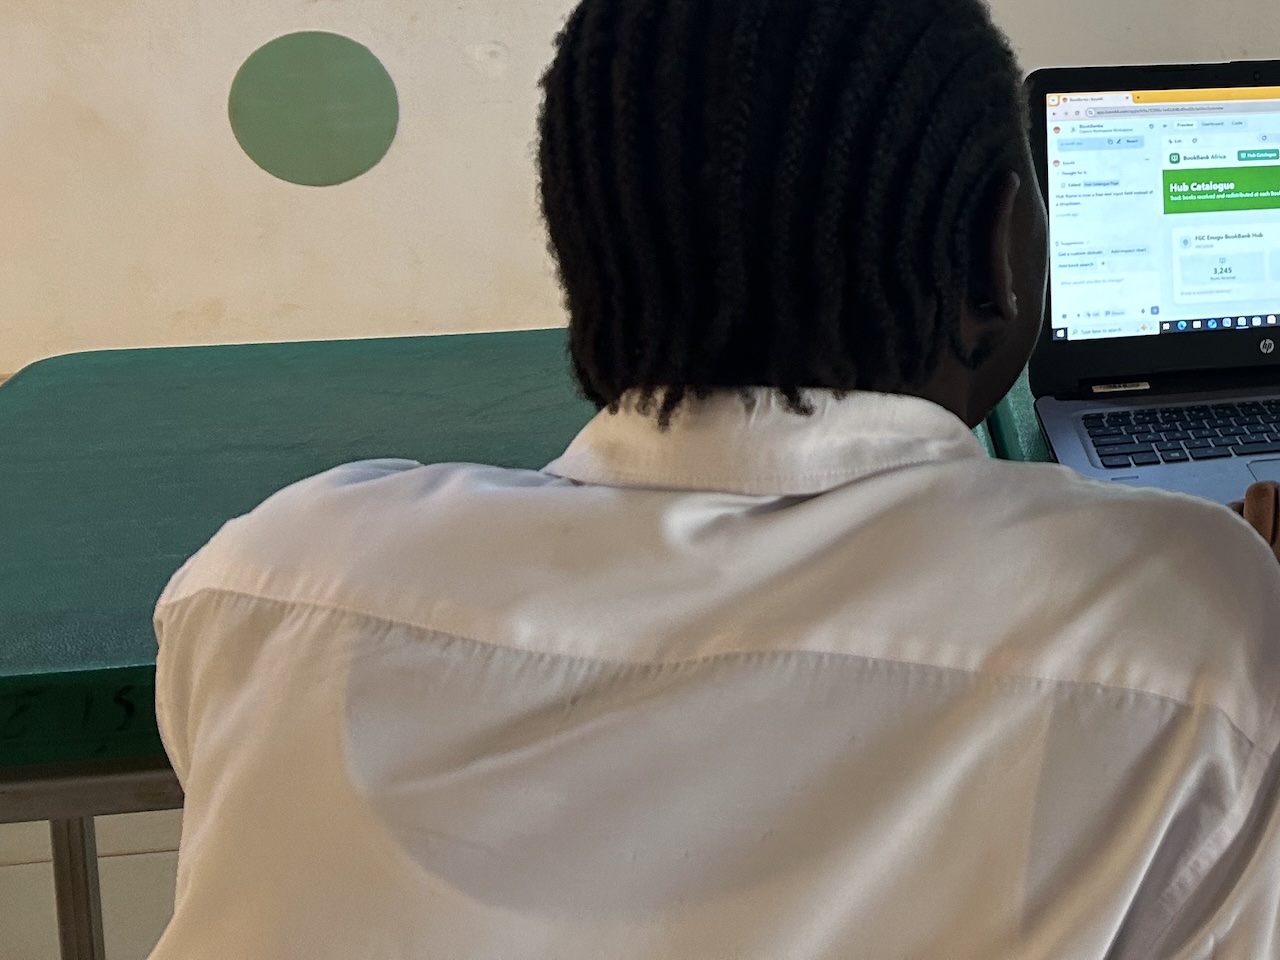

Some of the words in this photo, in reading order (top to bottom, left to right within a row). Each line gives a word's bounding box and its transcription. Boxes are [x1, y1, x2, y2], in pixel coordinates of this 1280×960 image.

[1170, 182, 1189, 193] Hub
[1190, 181, 1235, 193] Catalogue
[1213, 266, 1233, 276] 3,245
[1261, 339, 1273, 353] hp
